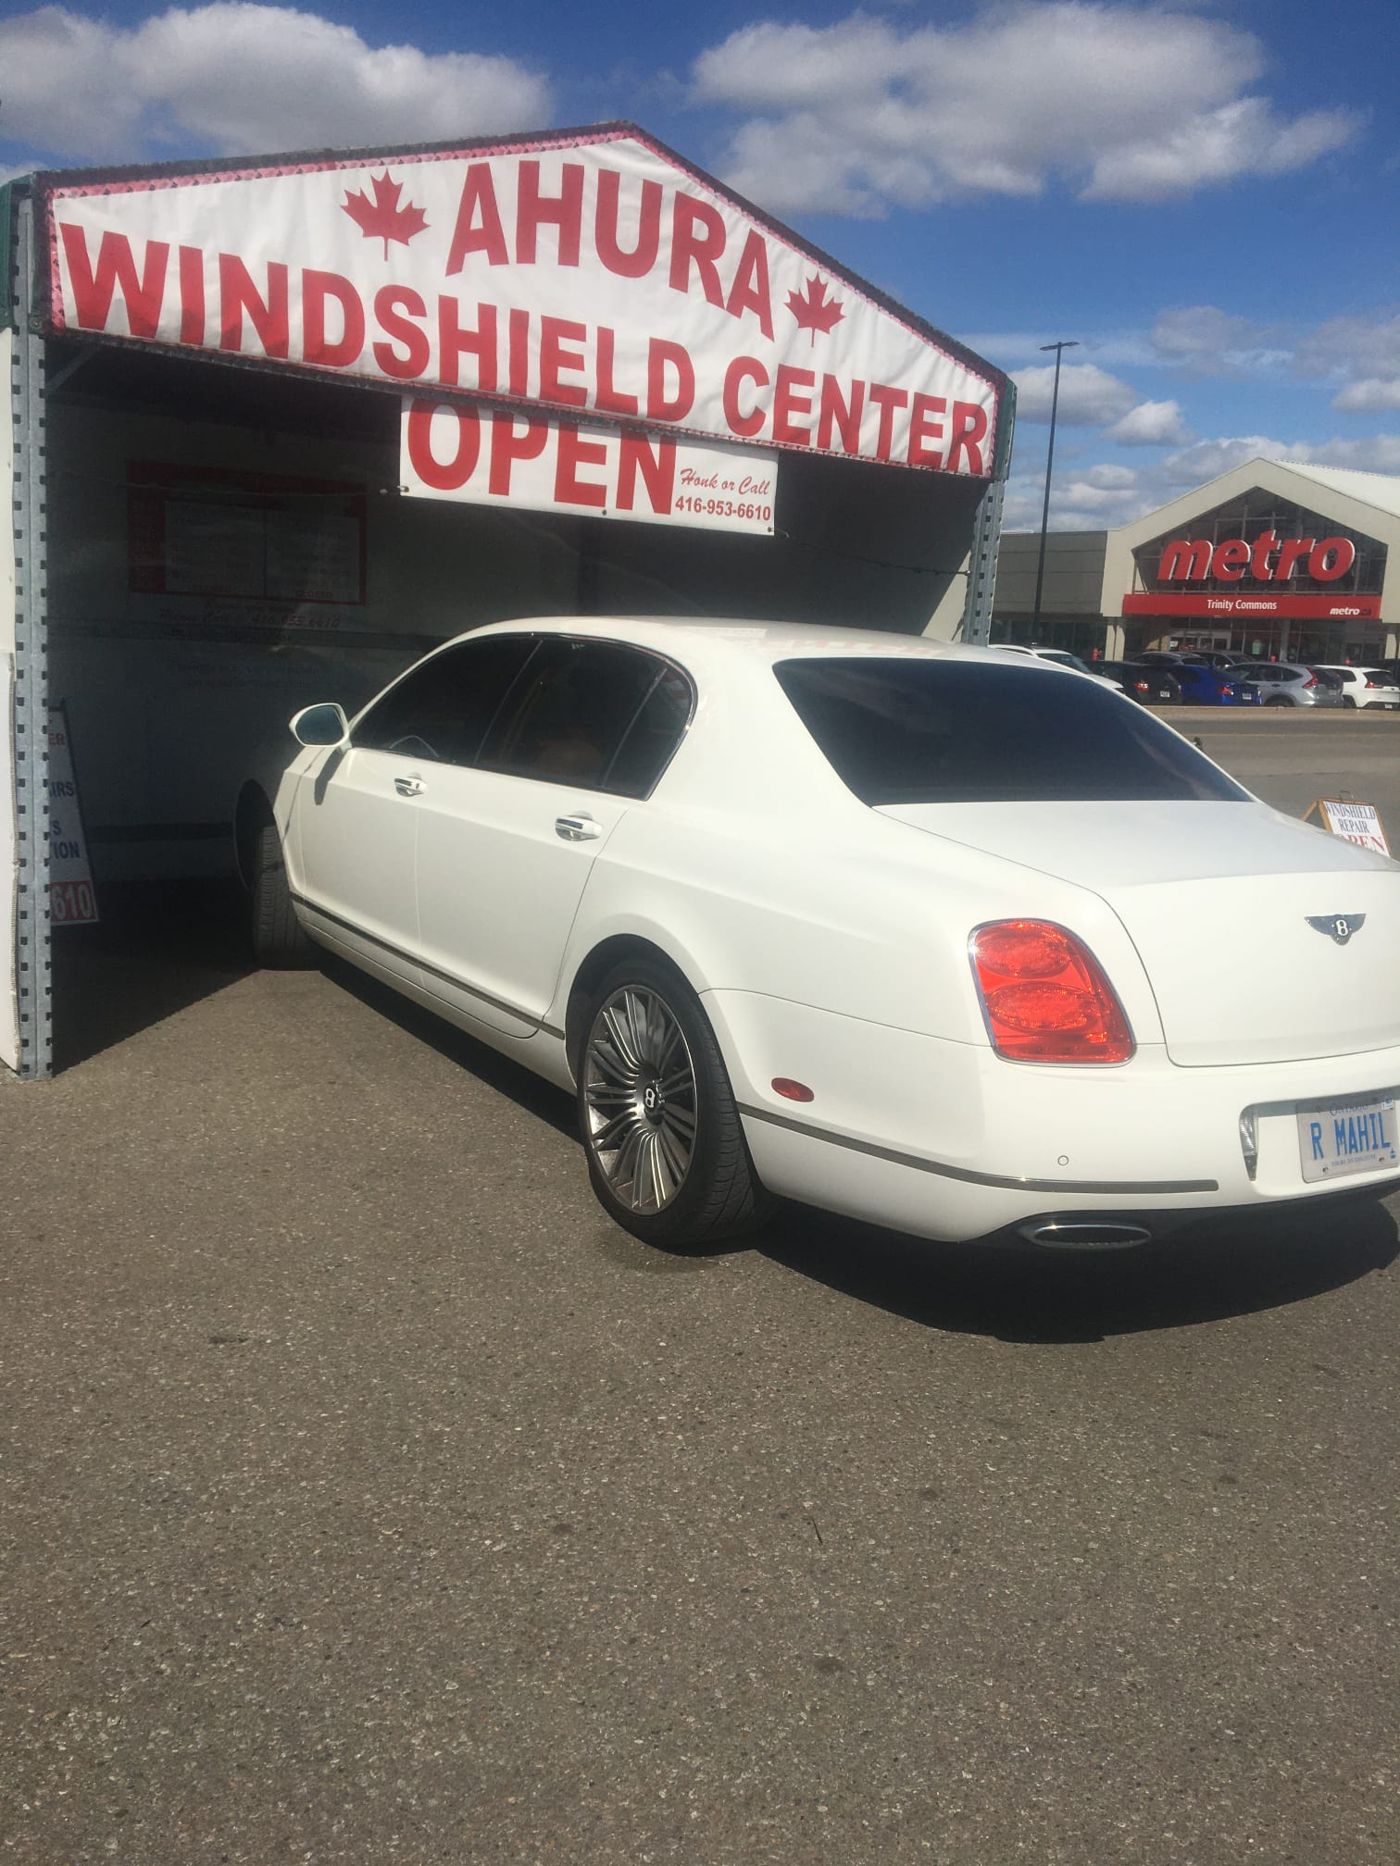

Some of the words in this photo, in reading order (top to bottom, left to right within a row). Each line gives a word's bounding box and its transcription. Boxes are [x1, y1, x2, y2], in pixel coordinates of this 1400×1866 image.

[446, 161, 774, 342] AHURA
[59, 222, 696, 422] WINDSHIELD
[722, 356, 988, 476] CENTER
[408, 401, 677, 516] OPEN
[680, 468, 719, 489] Honk
[721, 482, 735, 492] or
[738, 476, 771, 495] Call
[675, 495, 771, 521] 416-953-6610
[1157, 528, 1356, 582] metro
[1207, 599, 1233, 612] Trinity
[1235, 600, 1277, 611] Commons
[1338, 818, 1370, 833] REPAIR
[1342, 834, 1385, 852] PEN
[1310, 1122, 1325, 1161] R
[1333, 1111, 1391, 1157] MAHIL
